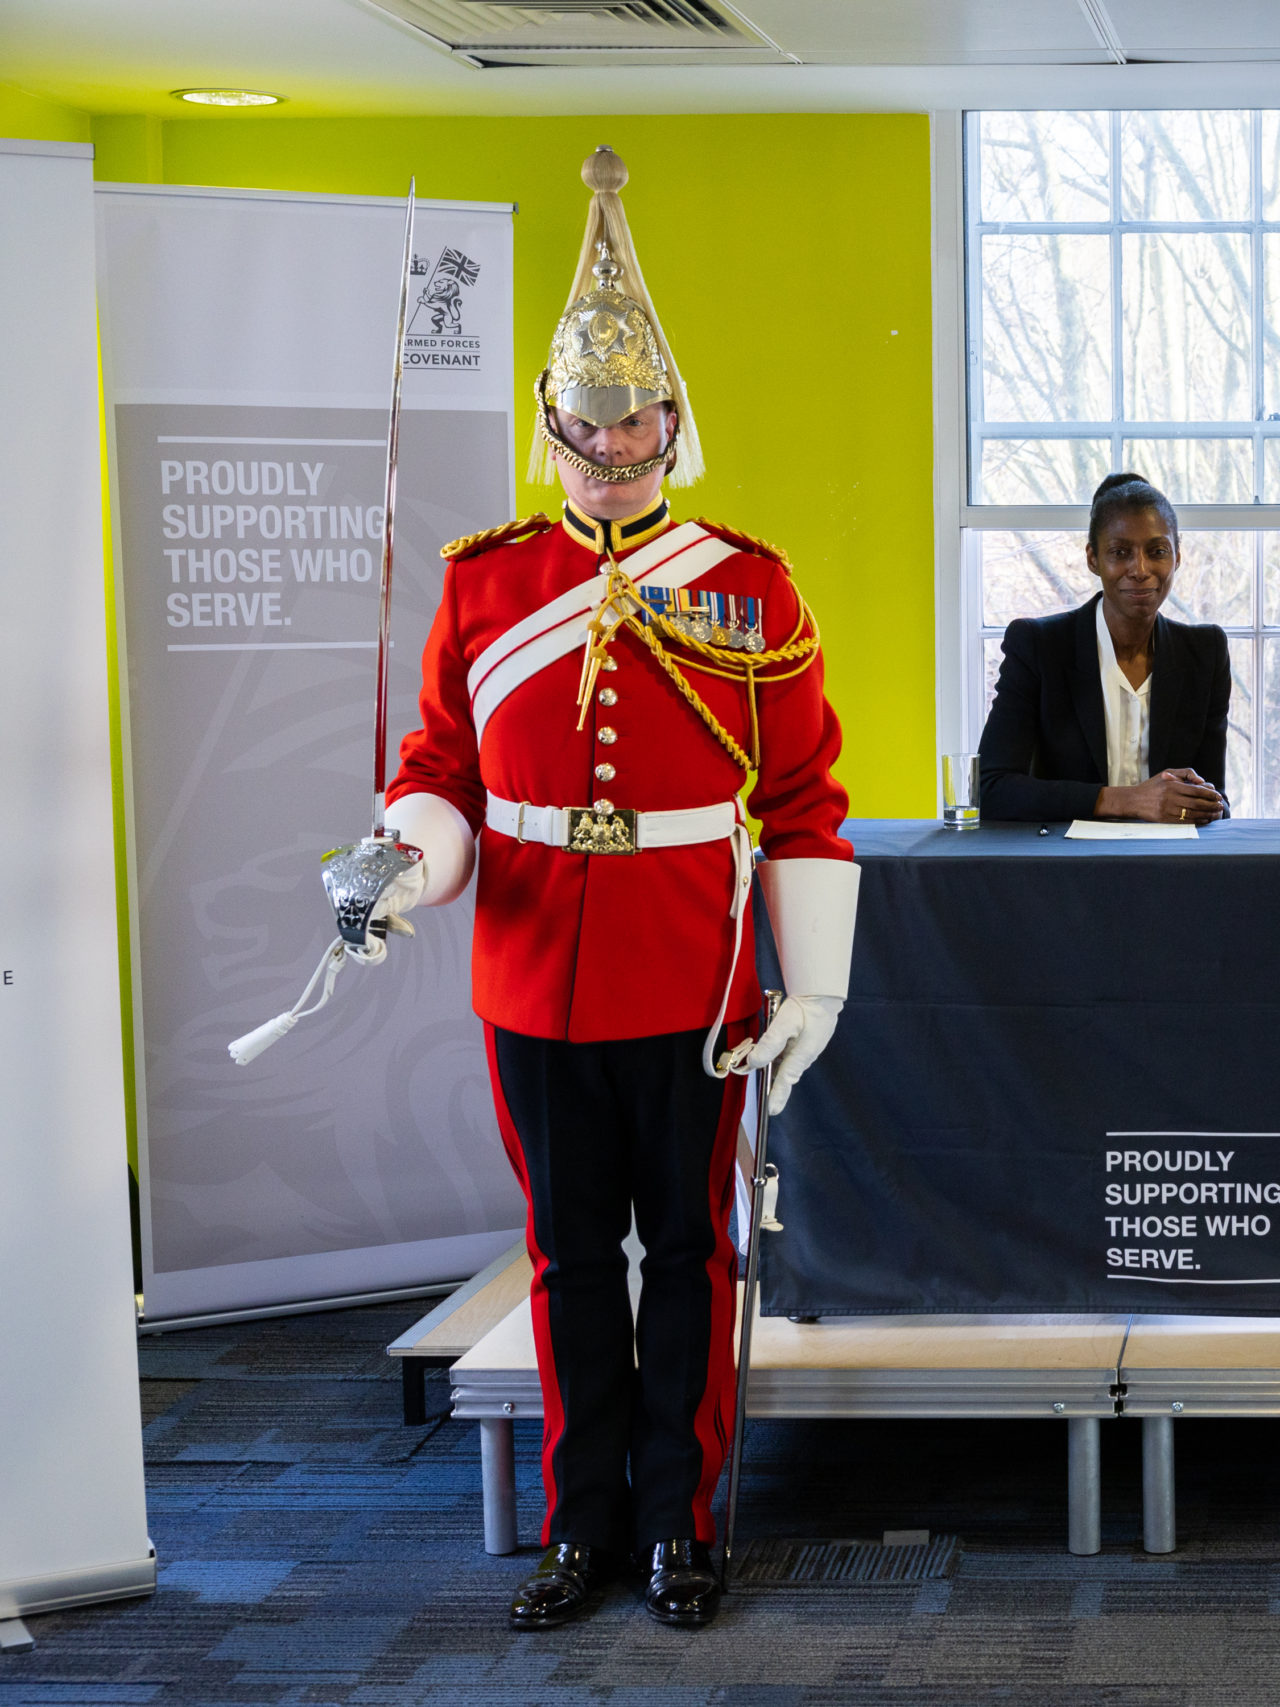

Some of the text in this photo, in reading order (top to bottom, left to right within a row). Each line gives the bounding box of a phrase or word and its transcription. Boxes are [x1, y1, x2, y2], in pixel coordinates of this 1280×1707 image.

[403, 338, 480, 349] RMED FORCES
[160, 460, 325, 496] PROUDLY
[162, 504, 386, 539] SUPPORTING
[163, 548, 373, 583] THOSE WHO
[166, 592, 292, 628] SERVE.
[1105, 1150, 1235, 1172] PROUDLY
[1104, 1214, 1271, 1238] THOSE WHO
[1106, 1247, 1201, 1270] SERVE.
